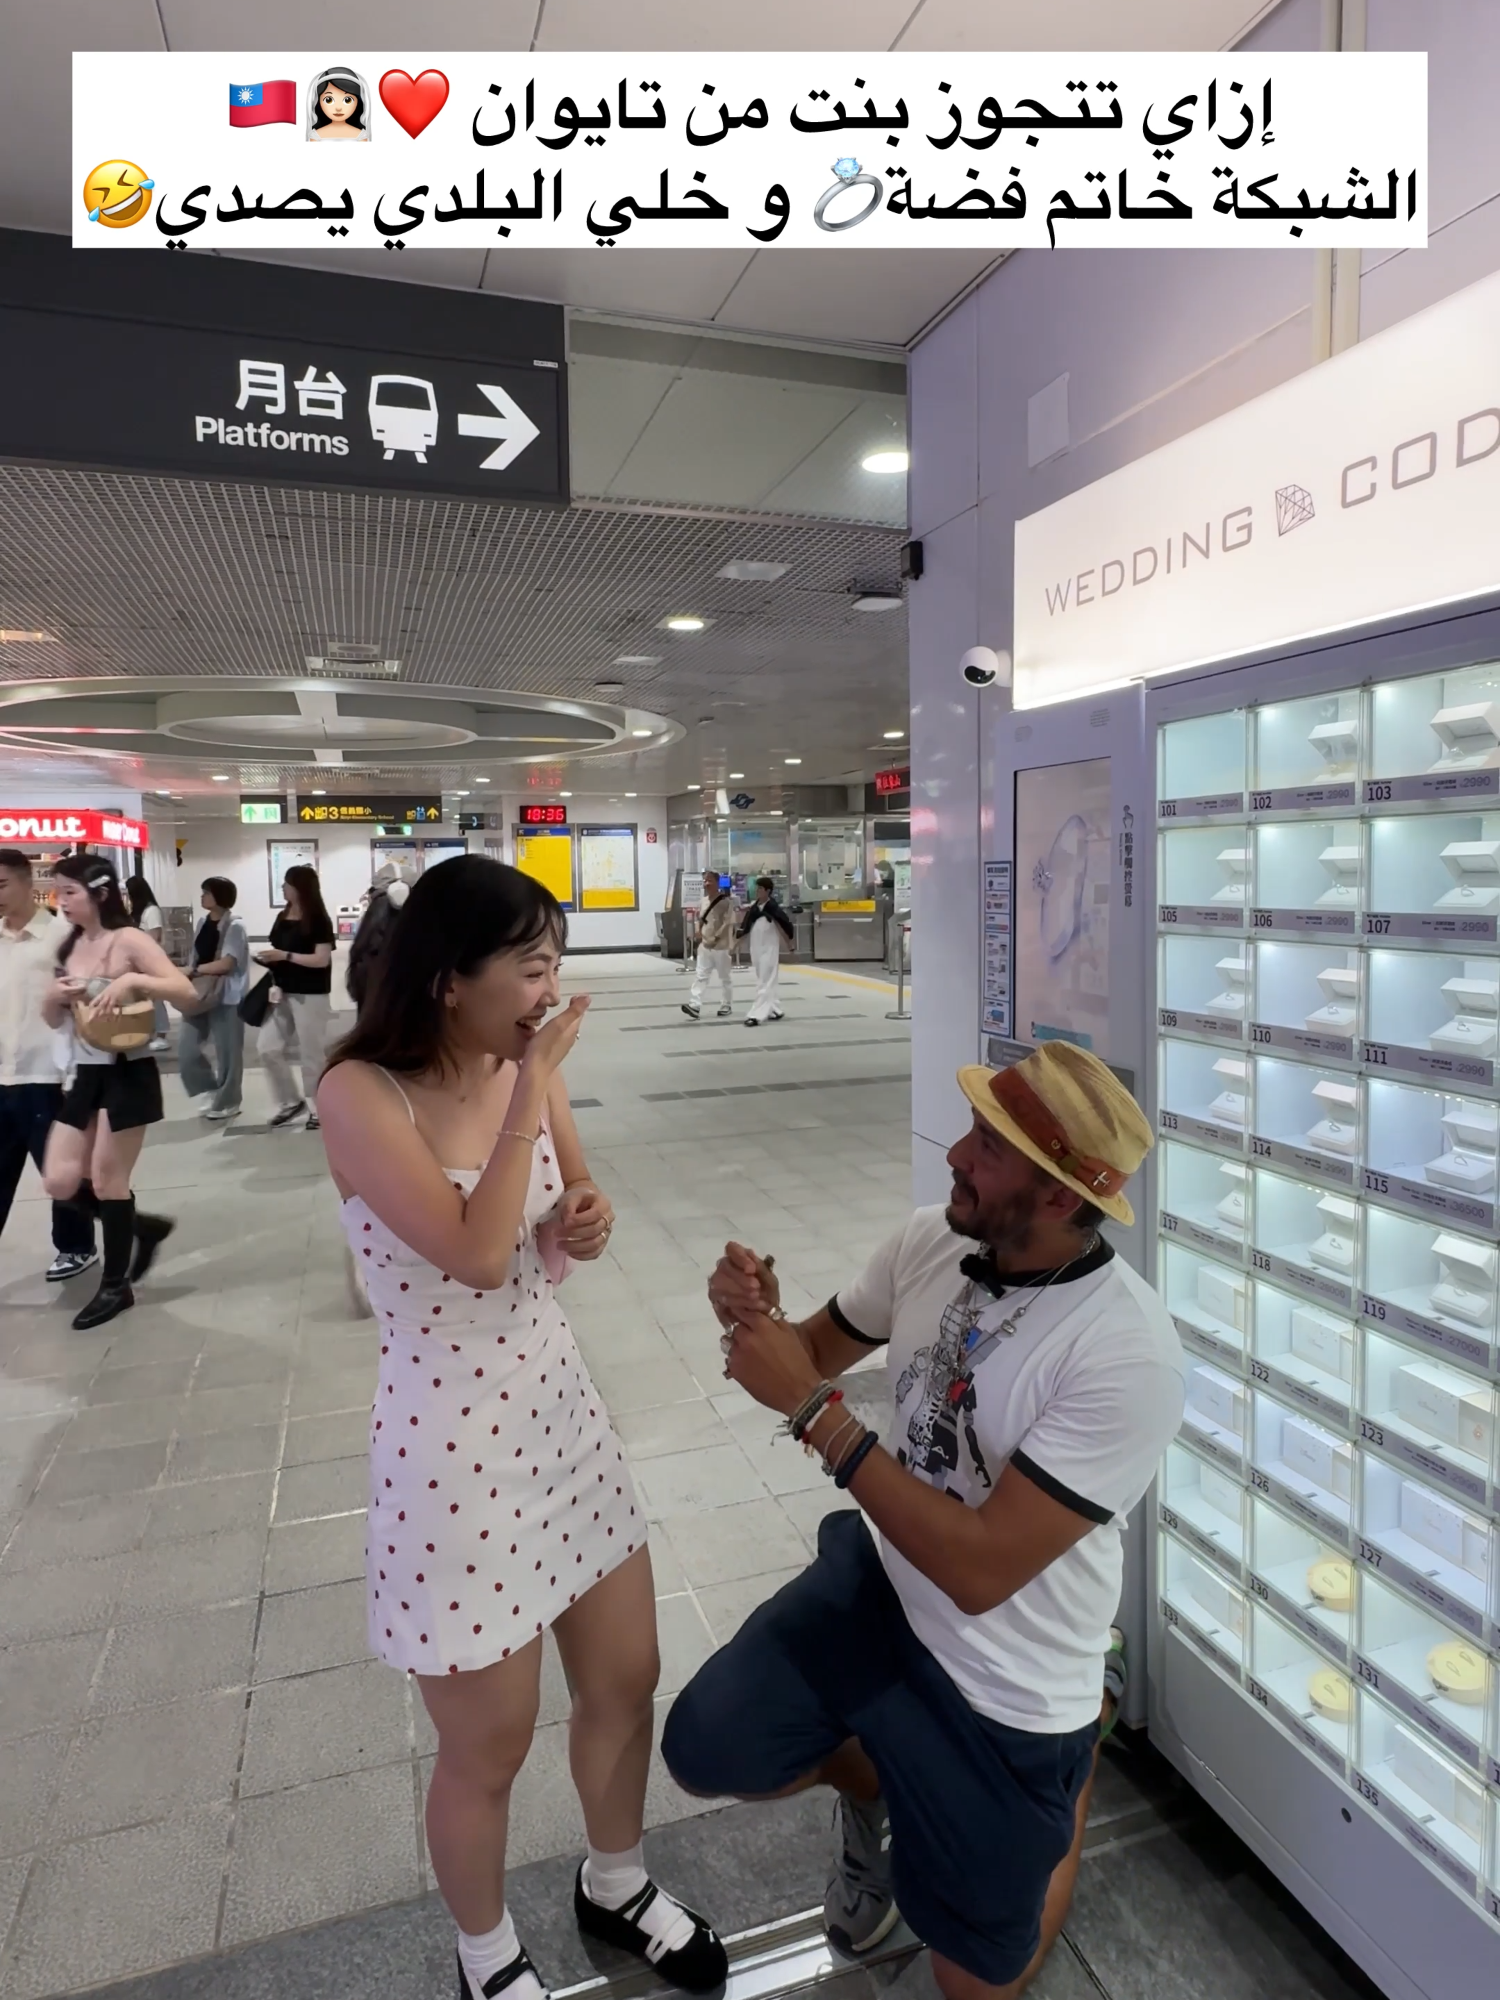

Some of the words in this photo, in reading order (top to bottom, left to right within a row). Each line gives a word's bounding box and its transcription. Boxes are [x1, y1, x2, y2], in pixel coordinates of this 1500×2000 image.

[235, 359, 347, 420] 月台
[195, 415, 350, 456] Platforms
[1045, 505, 1253, 617] WEDDING
[1367, 785, 1392, 801] 103
[1161, 804, 1177, 817] 101
[1253, 796, 1273, 810] 102
[328, 806, 339, 820] 3
[526, 808, 564, 821] 18:36
[0, 817, 87, 838] onut
[1161, 910, 1178, 923] 105
[1253, 914, 1273, 927] 106
[1367, 919, 1391, 934] 107
[1161, 1014, 1178, 1027] 109
[1252, 1029, 1272, 1043] 110
[1363, 1048, 1388, 1065] 111
[1162, 1115, 1178, 1129] 113
[1252, 1141, 1272, 1157] 114
[1365, 1175, 1389, 1194] 115
[1163, 1216, 1178, 1231] 117
[1252, 1253, 1271, 1271] 118
[1362, 1300, 1386, 1320] 119
[1251, 1363, 1270, 1384] 122
[1361, 1423, 1384, 1446] 123
[1251, 1472, 1270, 1493] 126
[1162, 1510, 1178, 1529] 129
[1359, 1543, 1383, 1568] 127
[1250, 1578, 1269, 1601] 130
[1163, 1605, 1179, 1626] 133
[1358, 1662, 1380, 1689] 131
[1249, 1683, 1268, 1707] 134
[1356, 1778, 1379, 1806] 135
